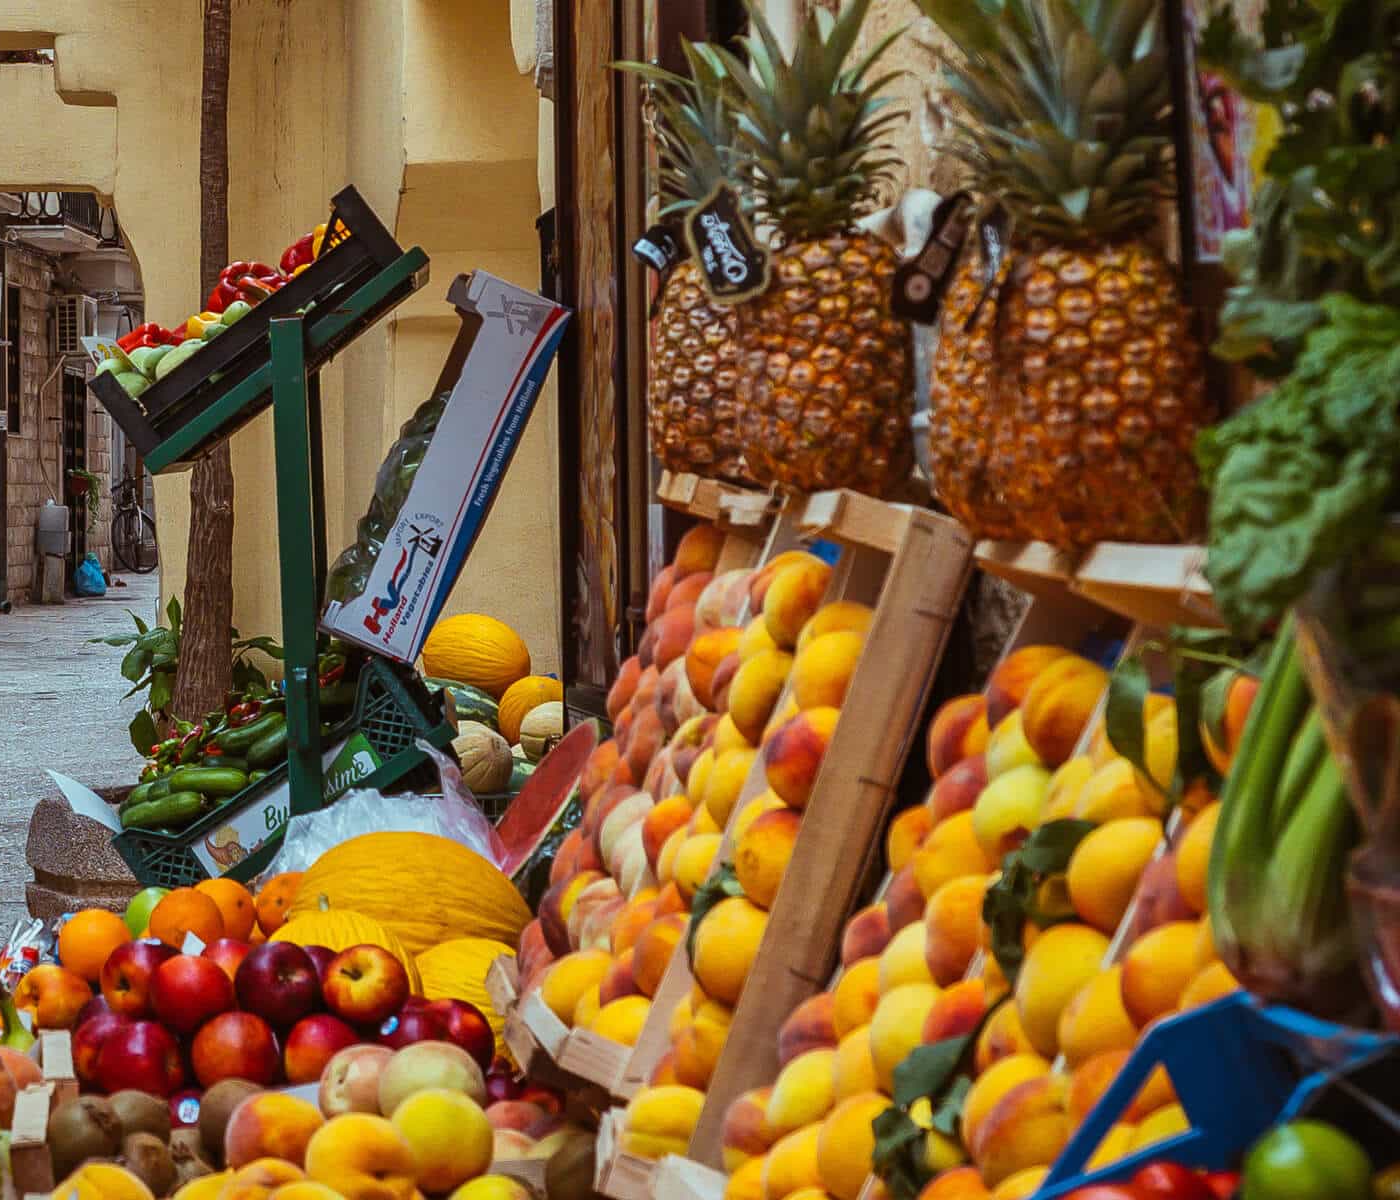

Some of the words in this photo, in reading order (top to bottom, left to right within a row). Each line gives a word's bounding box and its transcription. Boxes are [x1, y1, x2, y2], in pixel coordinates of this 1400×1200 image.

[473, 481, 490, 507] Fresh
[484, 435, 511, 482] Vegetables
[504, 412, 521, 436] from
[514, 378, 536, 413] Holland
[382, 594, 408, 645] Holland
[400, 560, 434, 626] Vegetables
